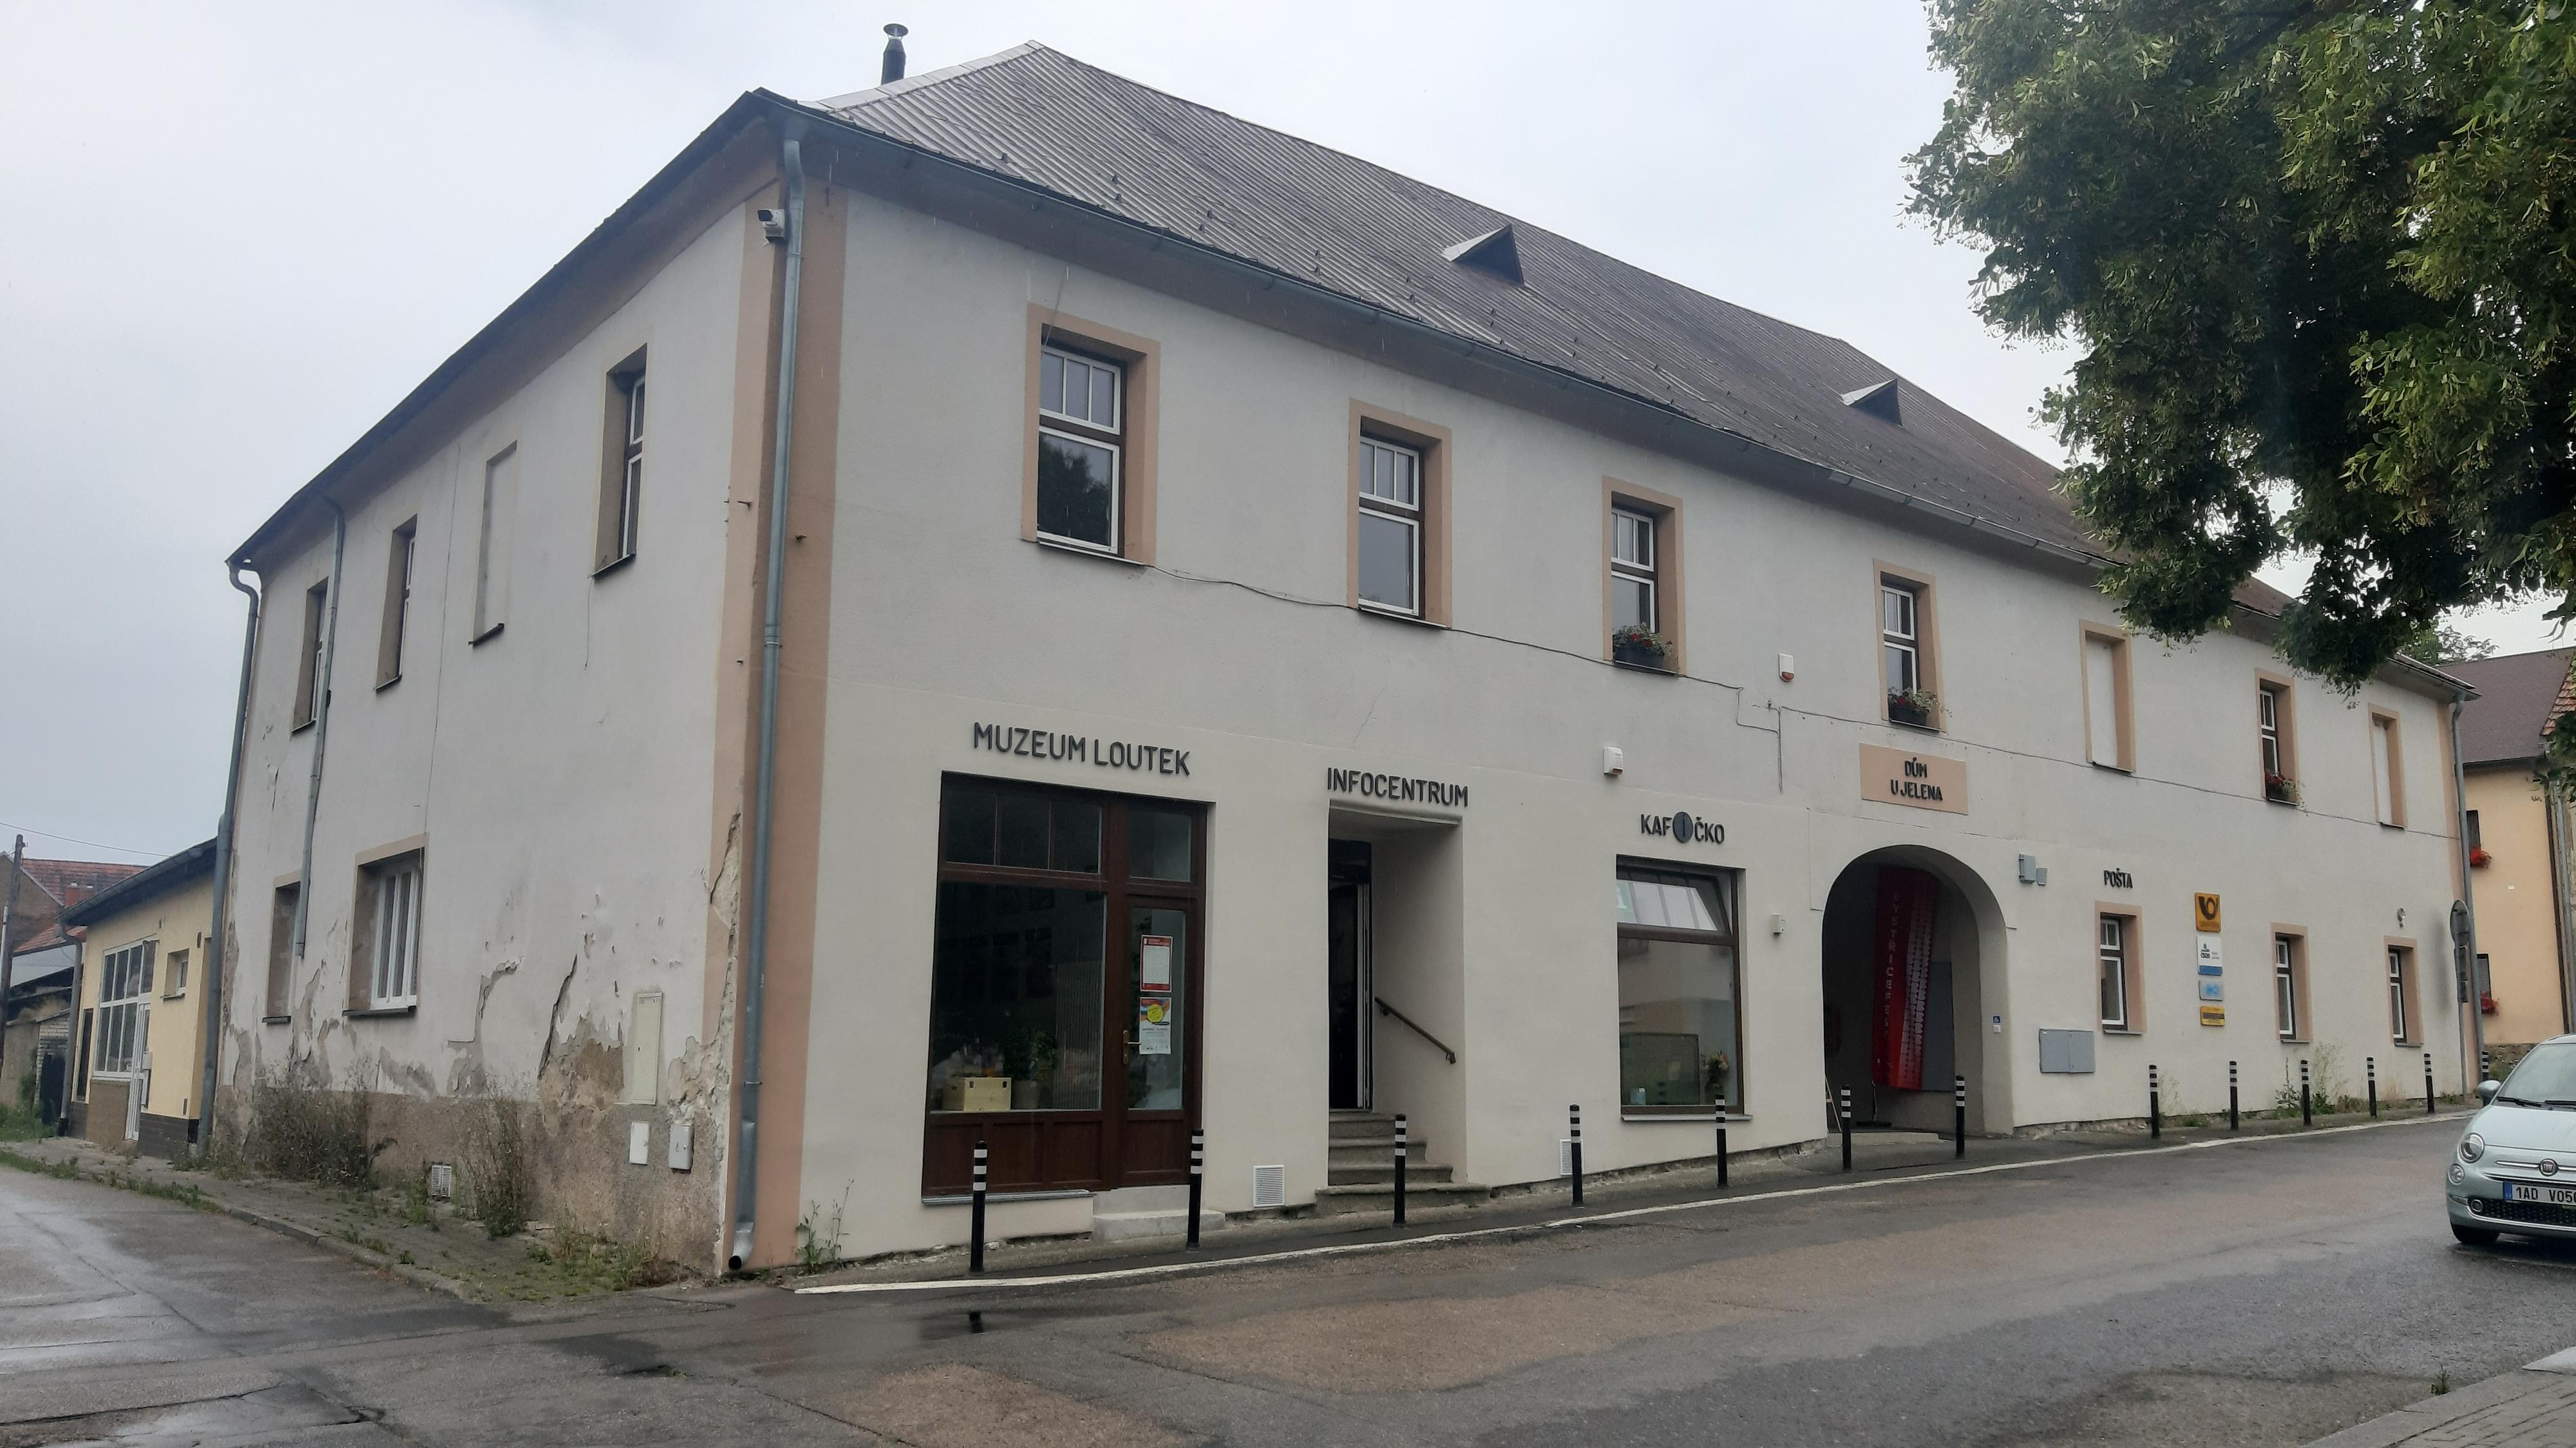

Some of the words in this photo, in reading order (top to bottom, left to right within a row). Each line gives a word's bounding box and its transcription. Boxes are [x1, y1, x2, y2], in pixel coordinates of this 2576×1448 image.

[973, 721, 1086, 762] MUZEUM
[1094, 738, 1191, 776] LOUTEK
[1904, 756, 1927, 778] DŮM
[1327, 767, 1468, 808] INFOCENTRUM
[1890, 779, 1899, 795] U
[1900, 781, 1943, 801] JELENA
[2103, 868, 2134, 889] POŠTA
[2515, 1186, 2539, 1200] 1AD
